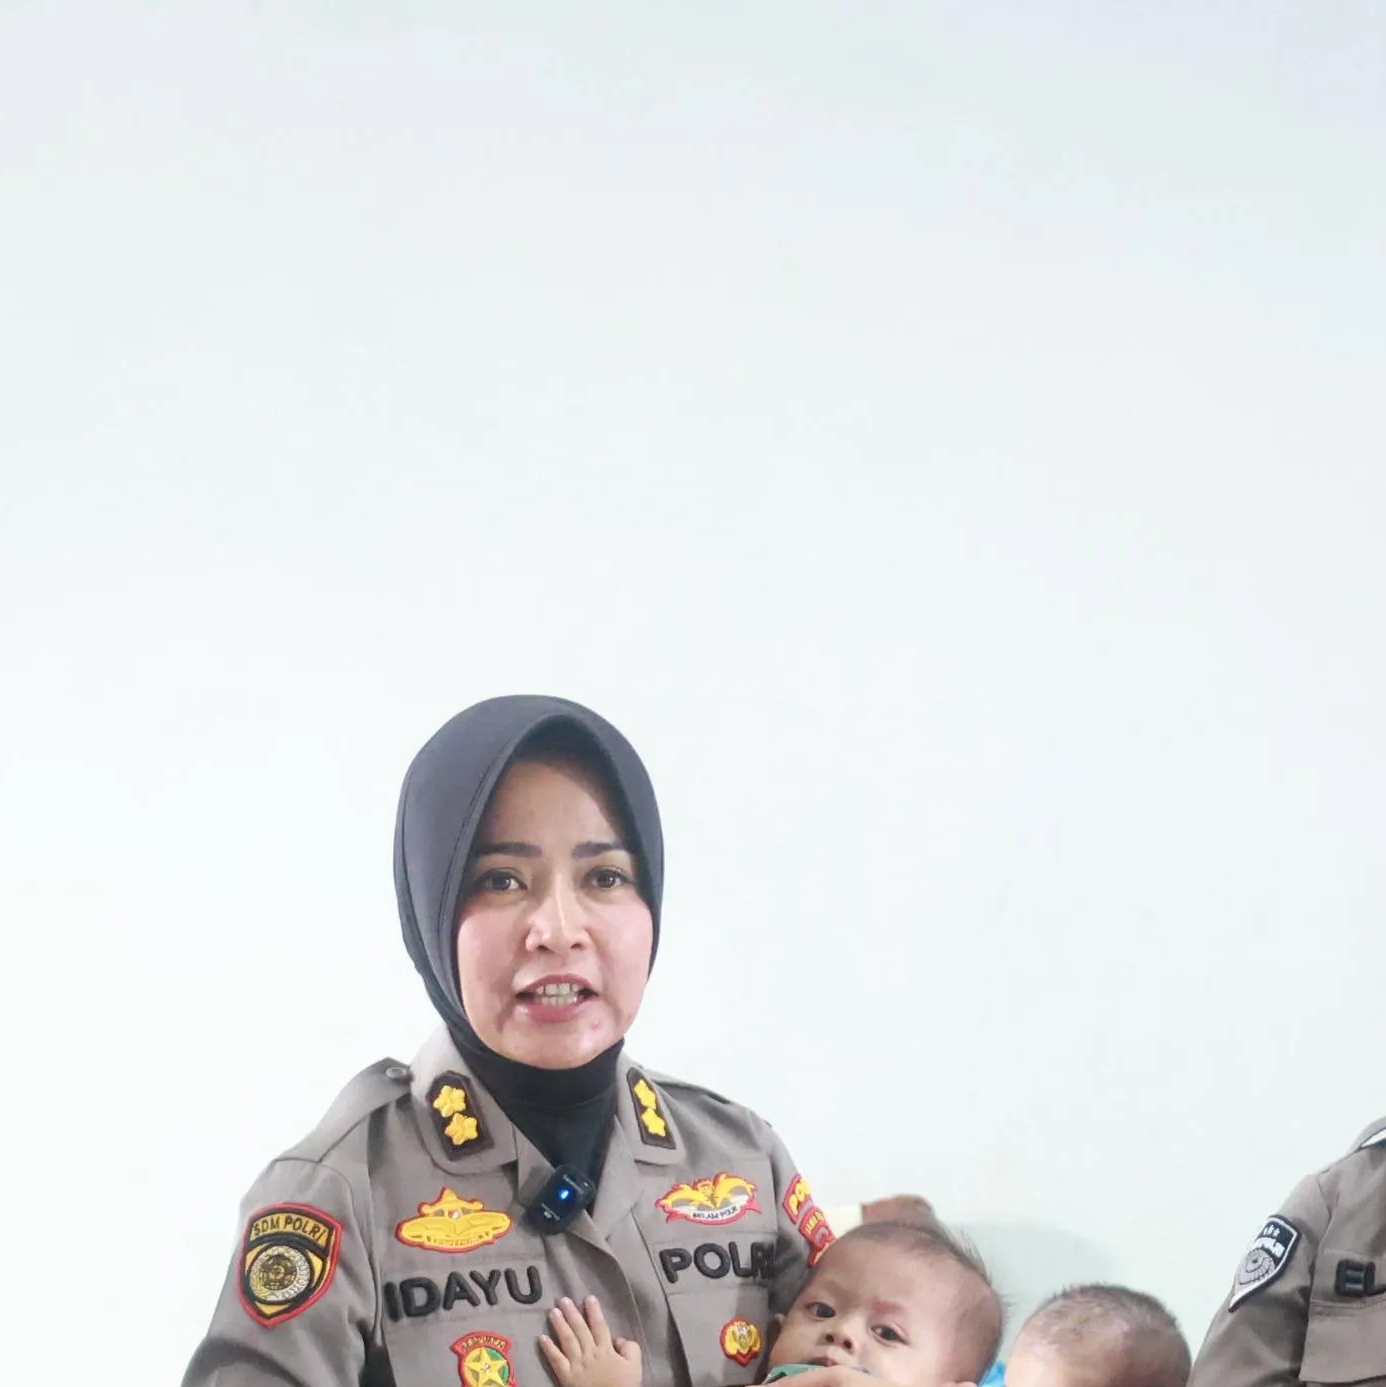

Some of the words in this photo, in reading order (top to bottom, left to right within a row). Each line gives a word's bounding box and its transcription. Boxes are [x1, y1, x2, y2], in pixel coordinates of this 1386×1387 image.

[253, 1218, 280, 1236] SDM
[284, 1215, 326, 1241] POLRI
[383, 1265, 543, 1322] IDAYU
